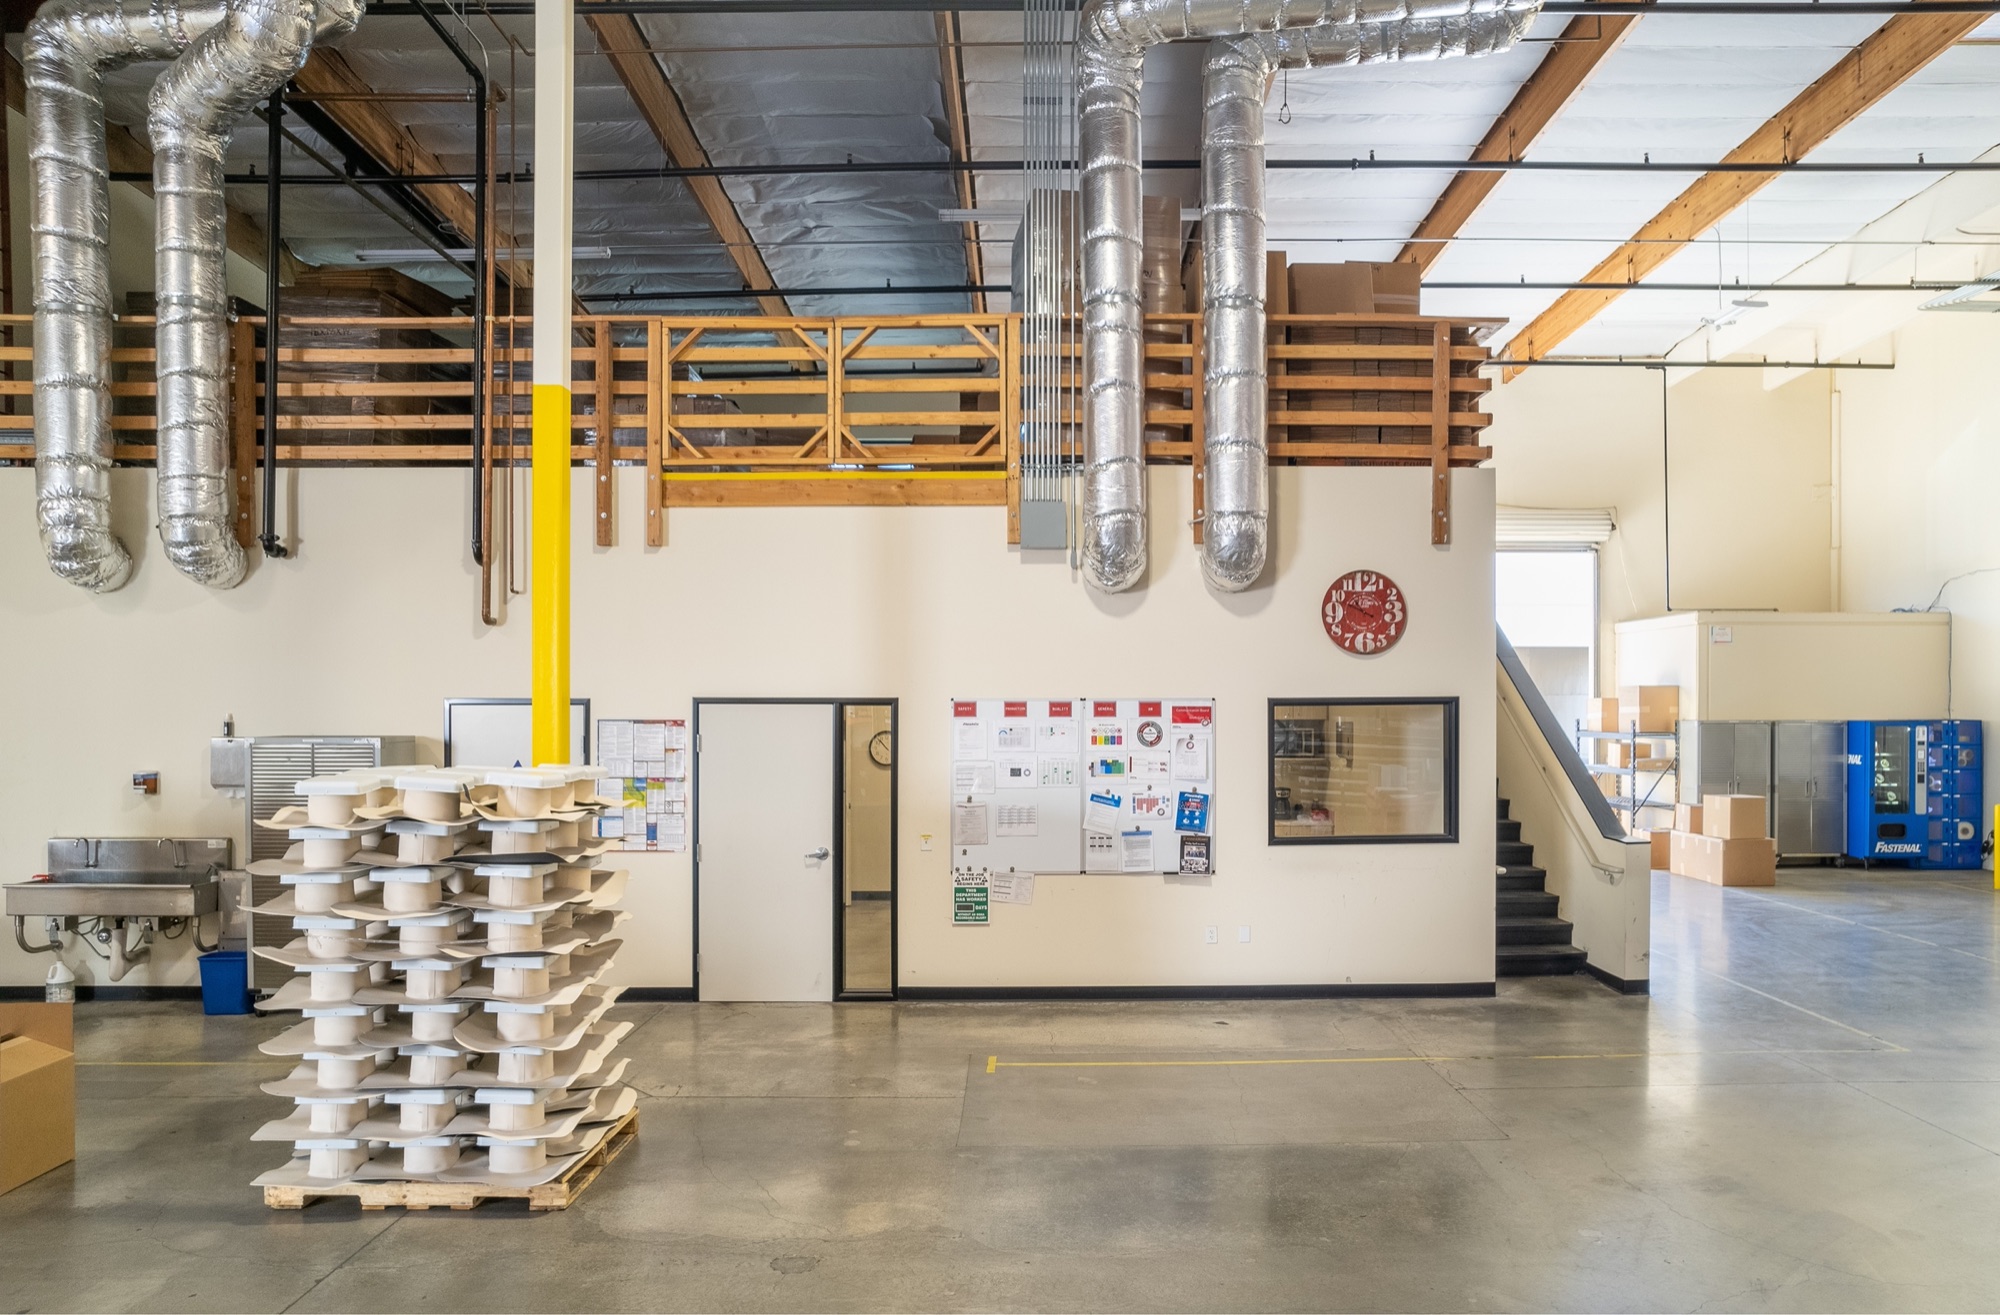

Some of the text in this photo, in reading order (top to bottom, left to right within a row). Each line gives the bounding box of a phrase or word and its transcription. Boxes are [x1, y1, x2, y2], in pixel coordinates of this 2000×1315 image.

[1342, 579, 1353, 591] 11
[1354, 572, 1377, 592] 12
[1378, 578, 1384, 590] 1
[1331, 589, 1345, 602] 10
[1386, 587, 1397, 601] 2
[1325, 601, 1343, 624] 9
[1384, 600, 1403, 623] 3
[1331, 623, 1342, 637] 8
[1386, 623, 1396, 636] 4
[1344, 632, 1355, 647] 7
[1354, 632, 1375, 653] 6
[1376, 634, 1387, 647] 5
[1875, 841, 1921, 853] FASTENAL
